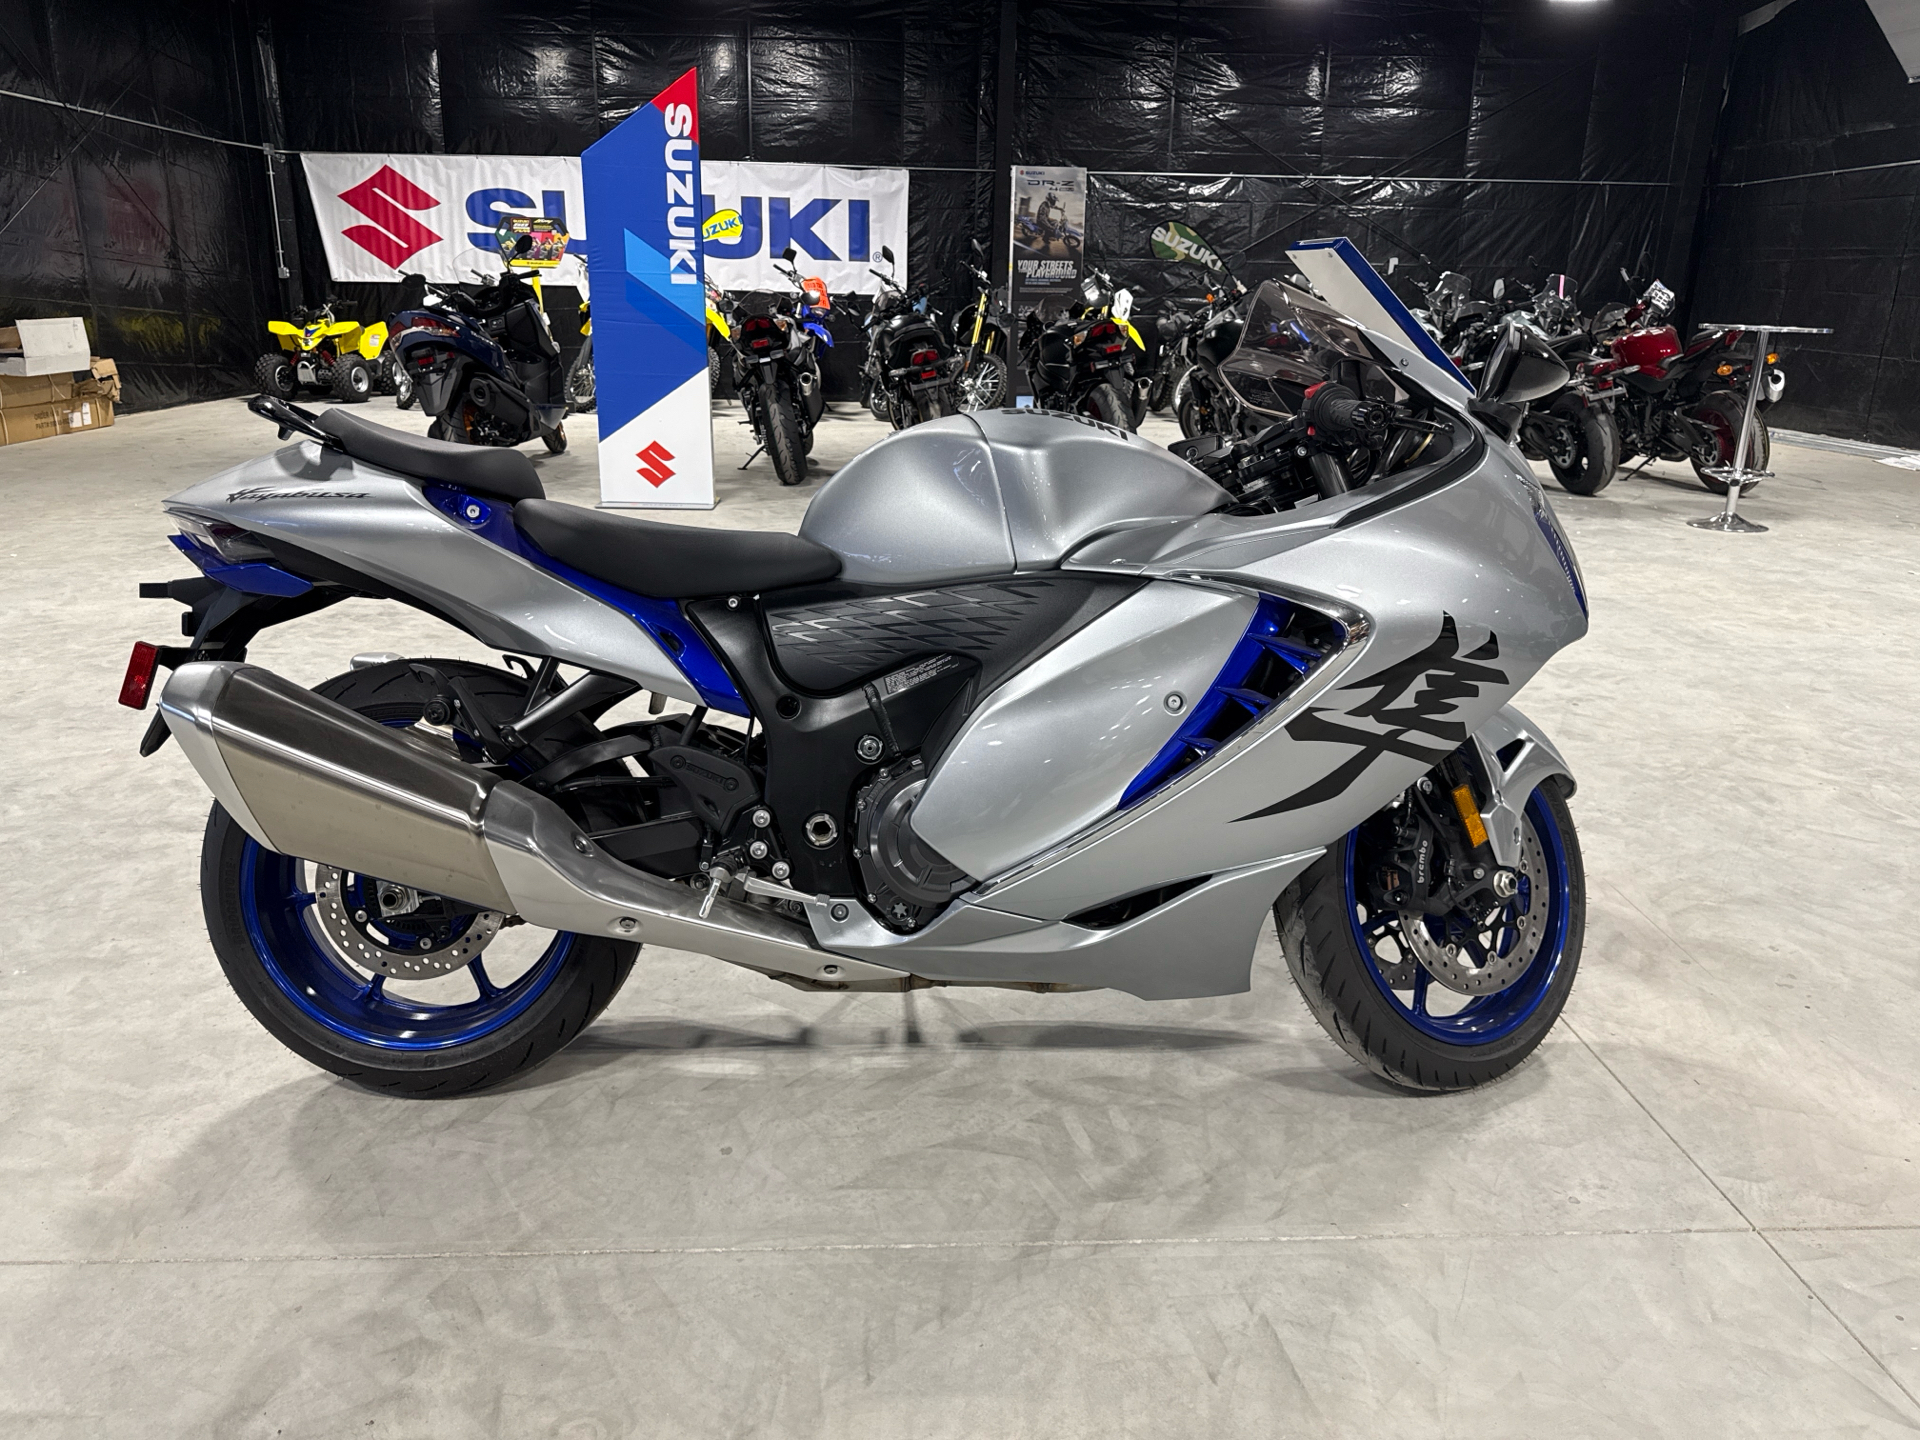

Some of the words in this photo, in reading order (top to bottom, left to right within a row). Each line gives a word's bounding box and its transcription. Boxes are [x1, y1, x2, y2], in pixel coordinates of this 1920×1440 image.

[664, 103, 698, 284] SUZUKI
[1026, 179, 1075, 187] DR-Z
[1017, 259, 1039, 271] YOUR
[1040, 260, 1075, 271] STREETS
[1151, 226, 1223, 272] SUZUKI
[1025, 268, 1078, 279] PLAYGROUND
[1000, 408, 1129, 441] SUZUKI
[1416, 839, 1429, 884] brembo
